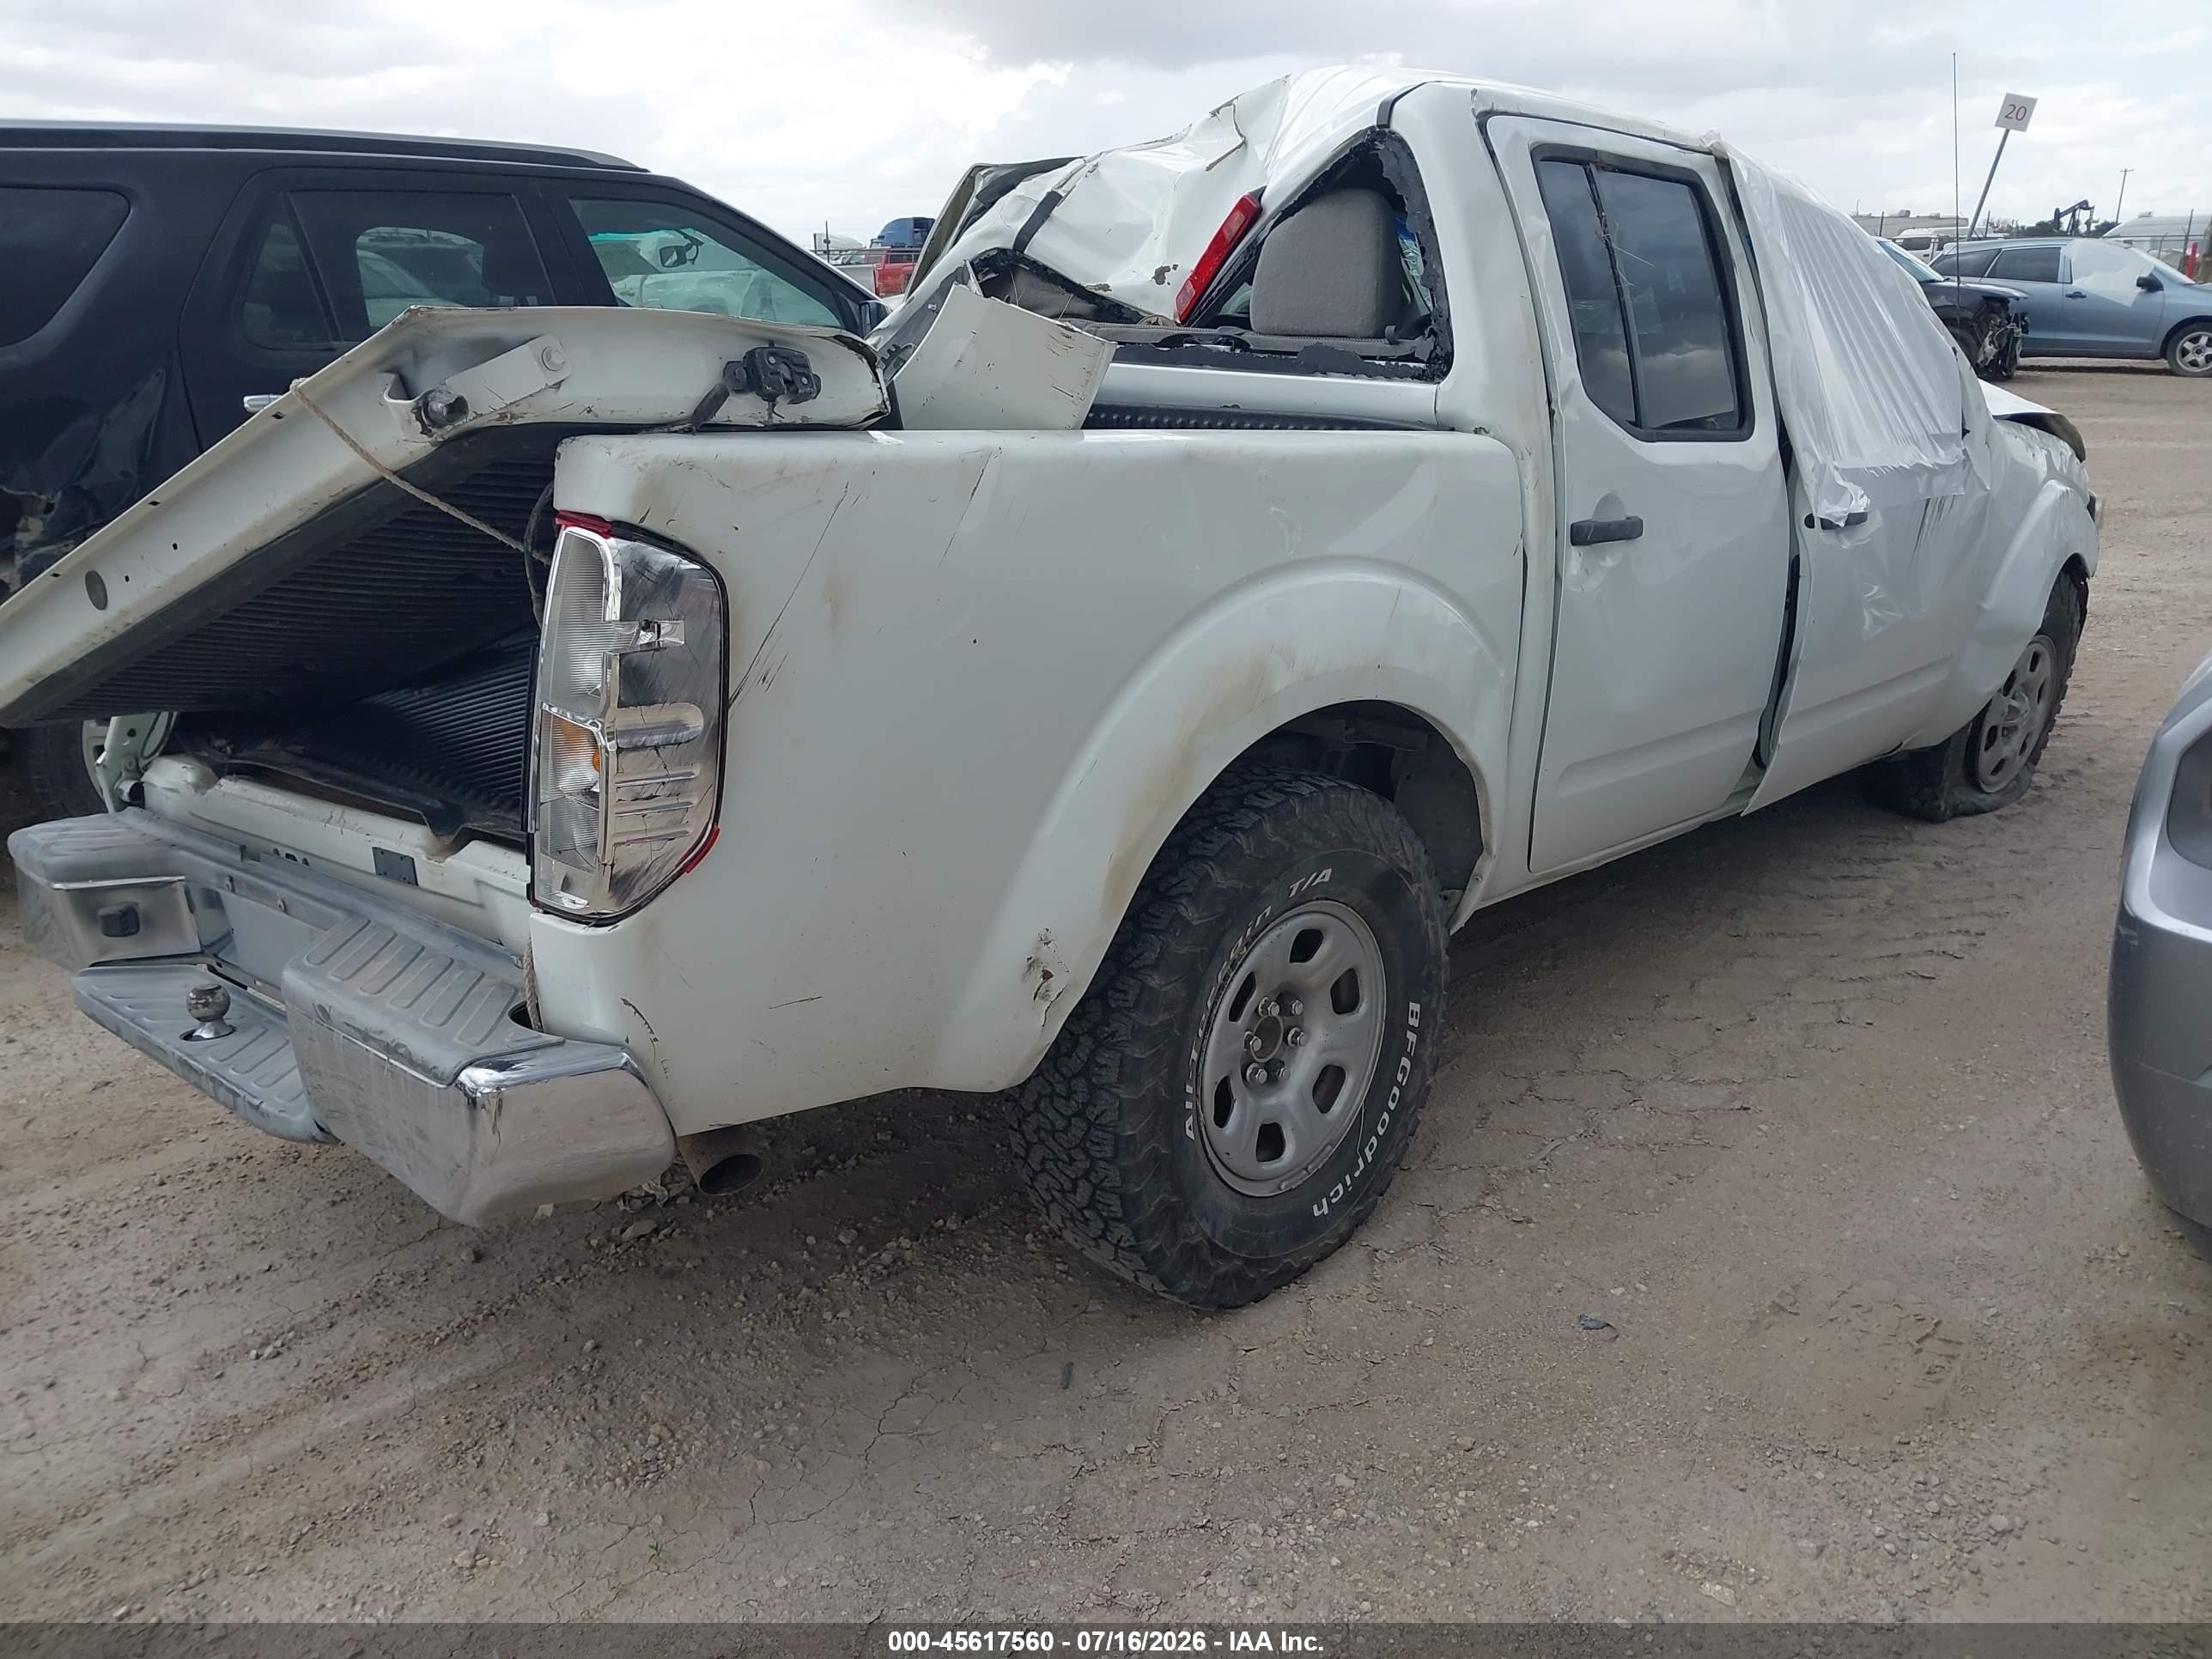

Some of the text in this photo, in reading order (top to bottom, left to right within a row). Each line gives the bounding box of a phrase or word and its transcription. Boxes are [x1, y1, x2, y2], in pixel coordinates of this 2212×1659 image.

[2003, 103, 2027, 122] 20
[1287, 866, 1334, 898] T/A
[1312, 1000, 1421, 1218] BFGoodrich
